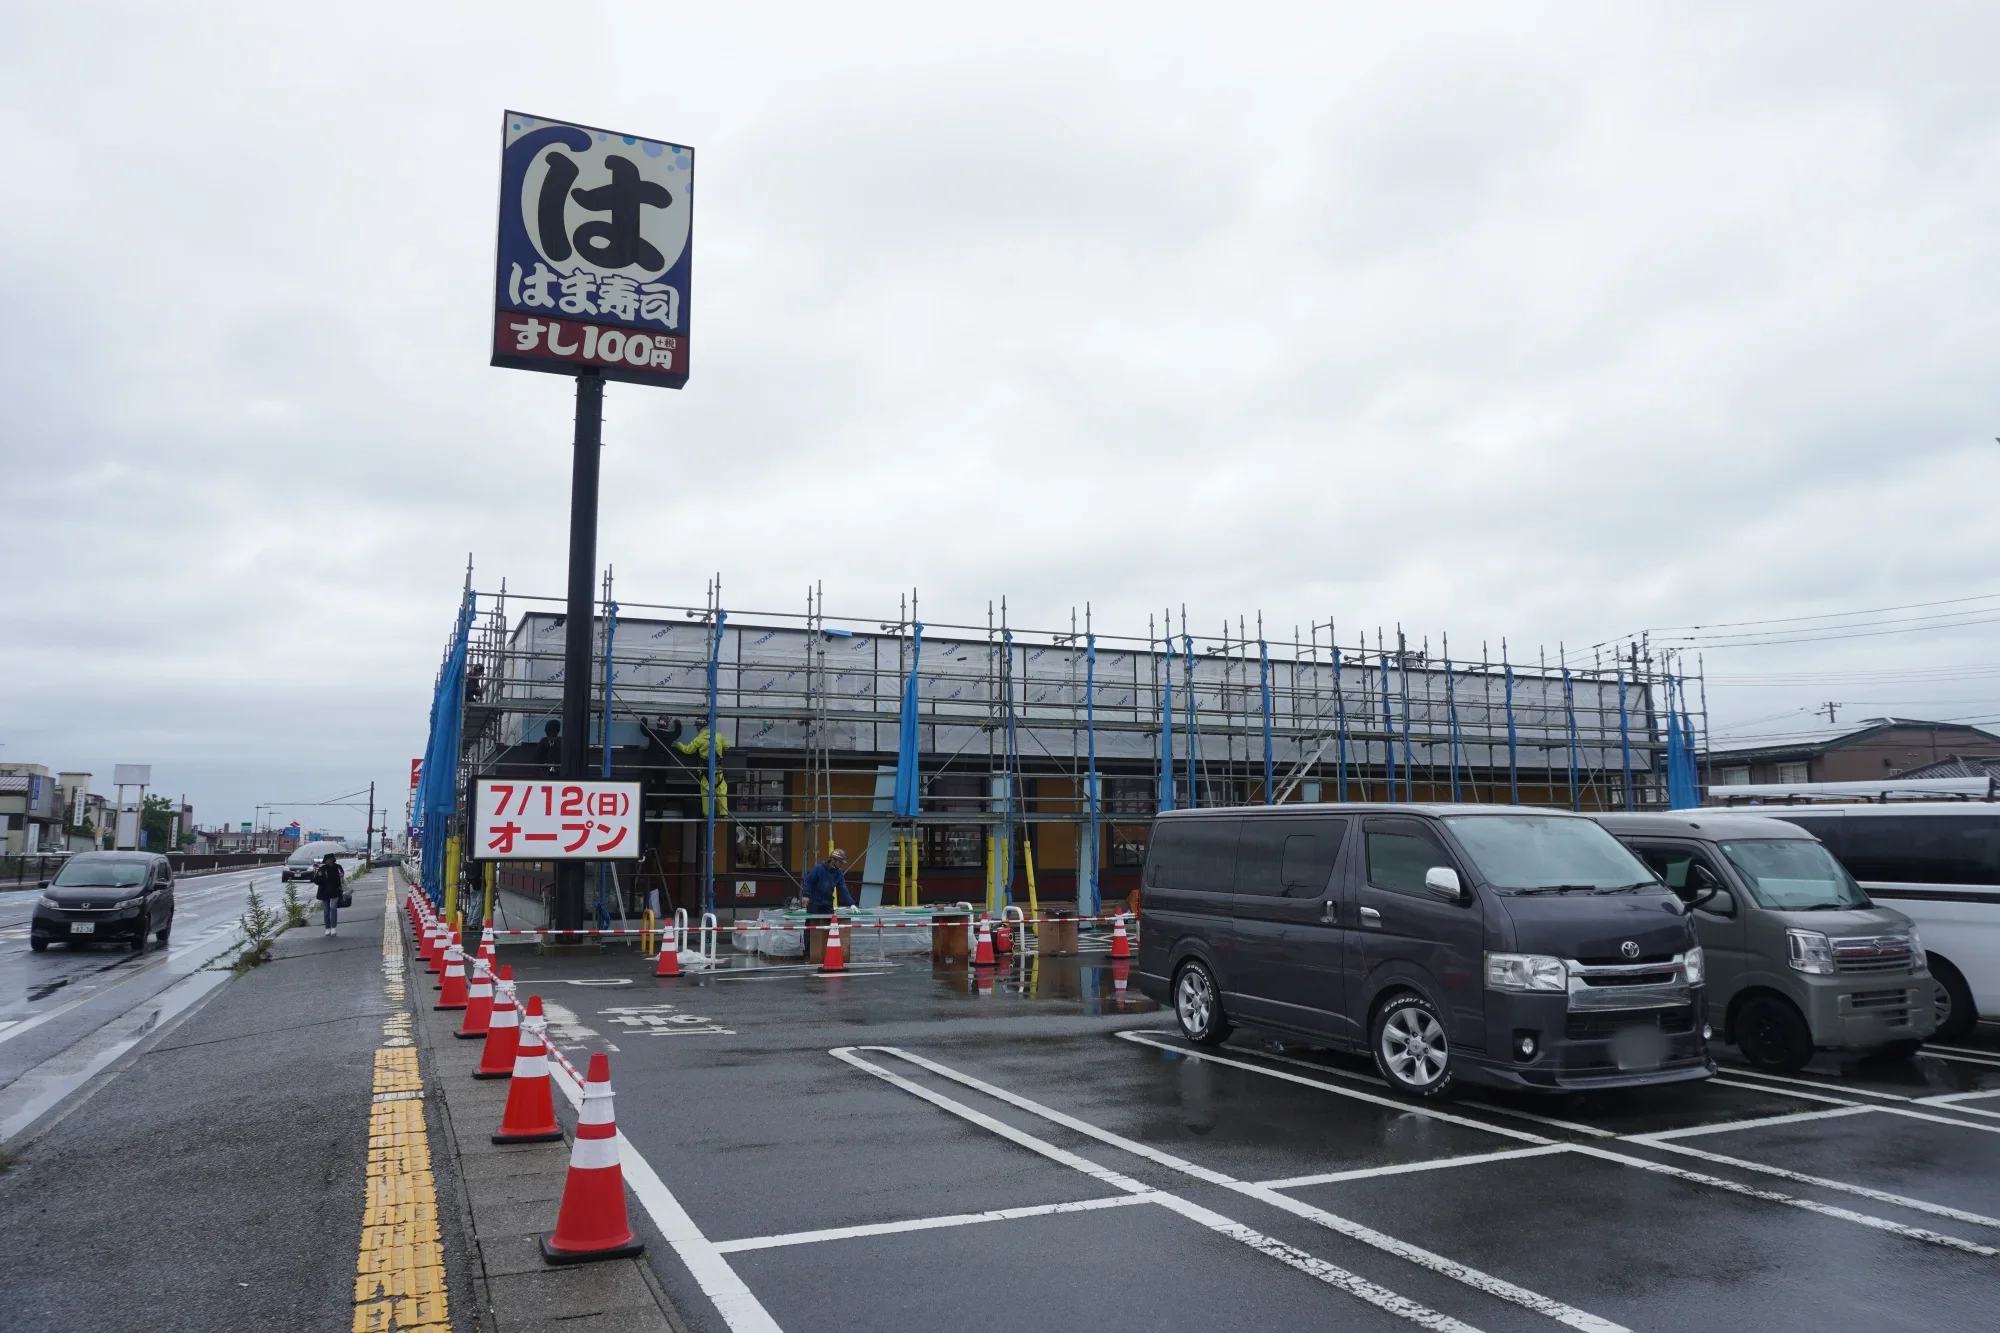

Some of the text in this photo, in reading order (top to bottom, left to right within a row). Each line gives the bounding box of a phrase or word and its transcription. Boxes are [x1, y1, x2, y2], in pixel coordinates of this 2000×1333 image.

[537, 151, 673, 272] は
[508, 261, 680, 330] はま寿司
[510, 318, 673, 370] すし100円
[657, 336, 676, 349] +税
[652, 624, 674, 640] TORAY
[755, 631, 776, 646] TORAY
[852, 637, 871, 652] TORAY
[943, 643, 961, 657] TORAY
[1029, 648, 1046, 662] TORAY
[1110, 653, 1126, 667] TORAY
[752, 721, 775, 739] TORAY
[490, 785, 630, 816] 7/12(日)
[487, 820, 628, 853] オープン
